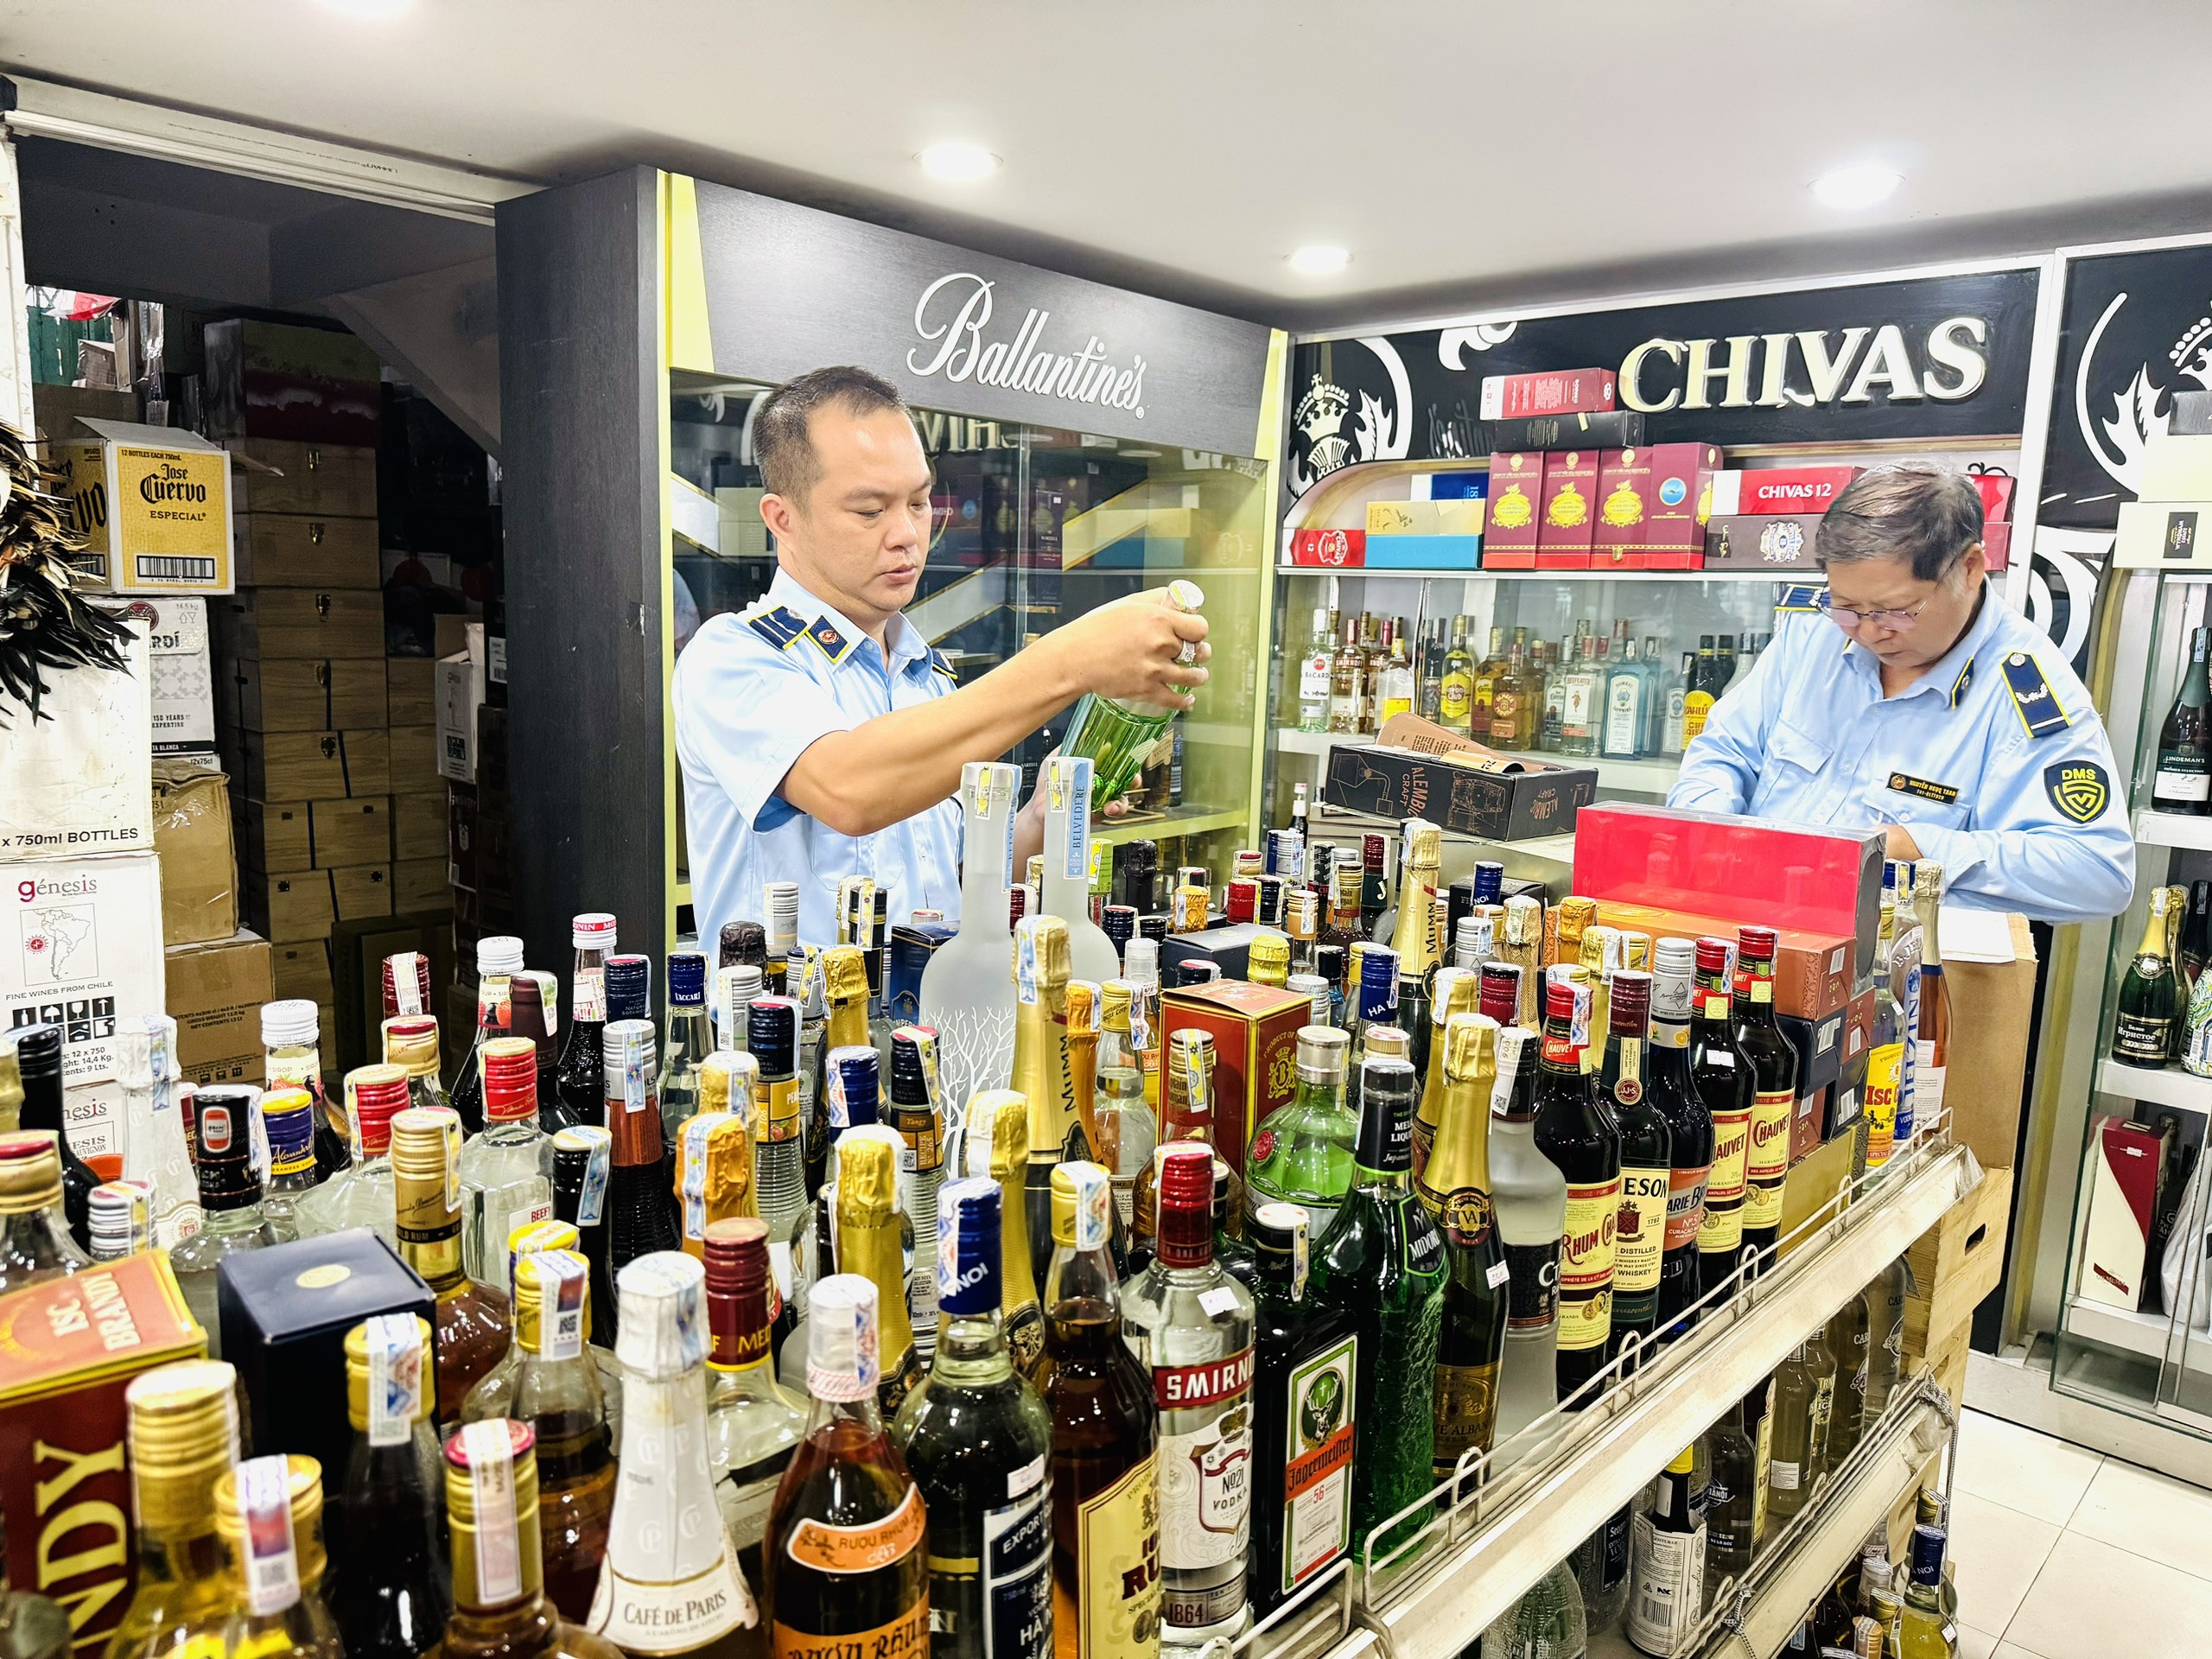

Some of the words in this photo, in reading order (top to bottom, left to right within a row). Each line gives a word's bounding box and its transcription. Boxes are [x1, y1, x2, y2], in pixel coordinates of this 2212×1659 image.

[907, 272, 1147, 411] Ballantine's
[1618, 317, 1987, 413] CHIVAS
[129, 449, 150, 458] BOTTLES
[161, 463, 188, 481] Jose
[140, 474, 207, 504] Cuervo
[1758, 483, 1814, 499] CHIVAS
[1815, 483, 1832, 498] 12
[150, 632, 180, 648] RDÍ
[2062, 769, 2096, 781] DMS
[1402, 773, 1410, 806] CRAFT
[1071, 785, 1085, 849] BELVEDERE
[2, 838, 10, 847] x
[16, 834, 62, 846] 750ml
[67, 828, 138, 843] BOTTLES
[18, 874, 97, 902] génesis
[1426, 901, 1437, 955] MUMM
[5, 993, 27, 1001] FINE
[29, 988, 59, 998] WINES
[60, 984, 86, 994] FROM
[87, 981, 114, 990] CHILE
[72, 1050, 81, 1058] 12
[1865, 1085, 1892, 1106] ISC
[1752, 1112, 1791, 1147] CHAUVET
[69, 1135, 106, 1150] ESIS
[1624, 1177, 1669, 1199] ESON
[410, 1230, 429, 1242] RUM
[1408, 1228, 1440, 1262] MIDORI
[1620, 1245, 1656, 1255] DISTILLED
[1618, 1268, 1652, 1278] WHISKEY
[84, 1271, 142, 1351] BRANDY
[1212, 1487, 1249, 1511] VODKA
[1313, 1484, 1325, 1504] 56
[880, 1517, 910, 1543] RHUM
[624, 1602, 660, 1626] CAFÉ
[664, 1608, 683, 1625] DE
[686, 1589, 728, 1621] PARIS
[1168, 1602, 1204, 1624] 1864
